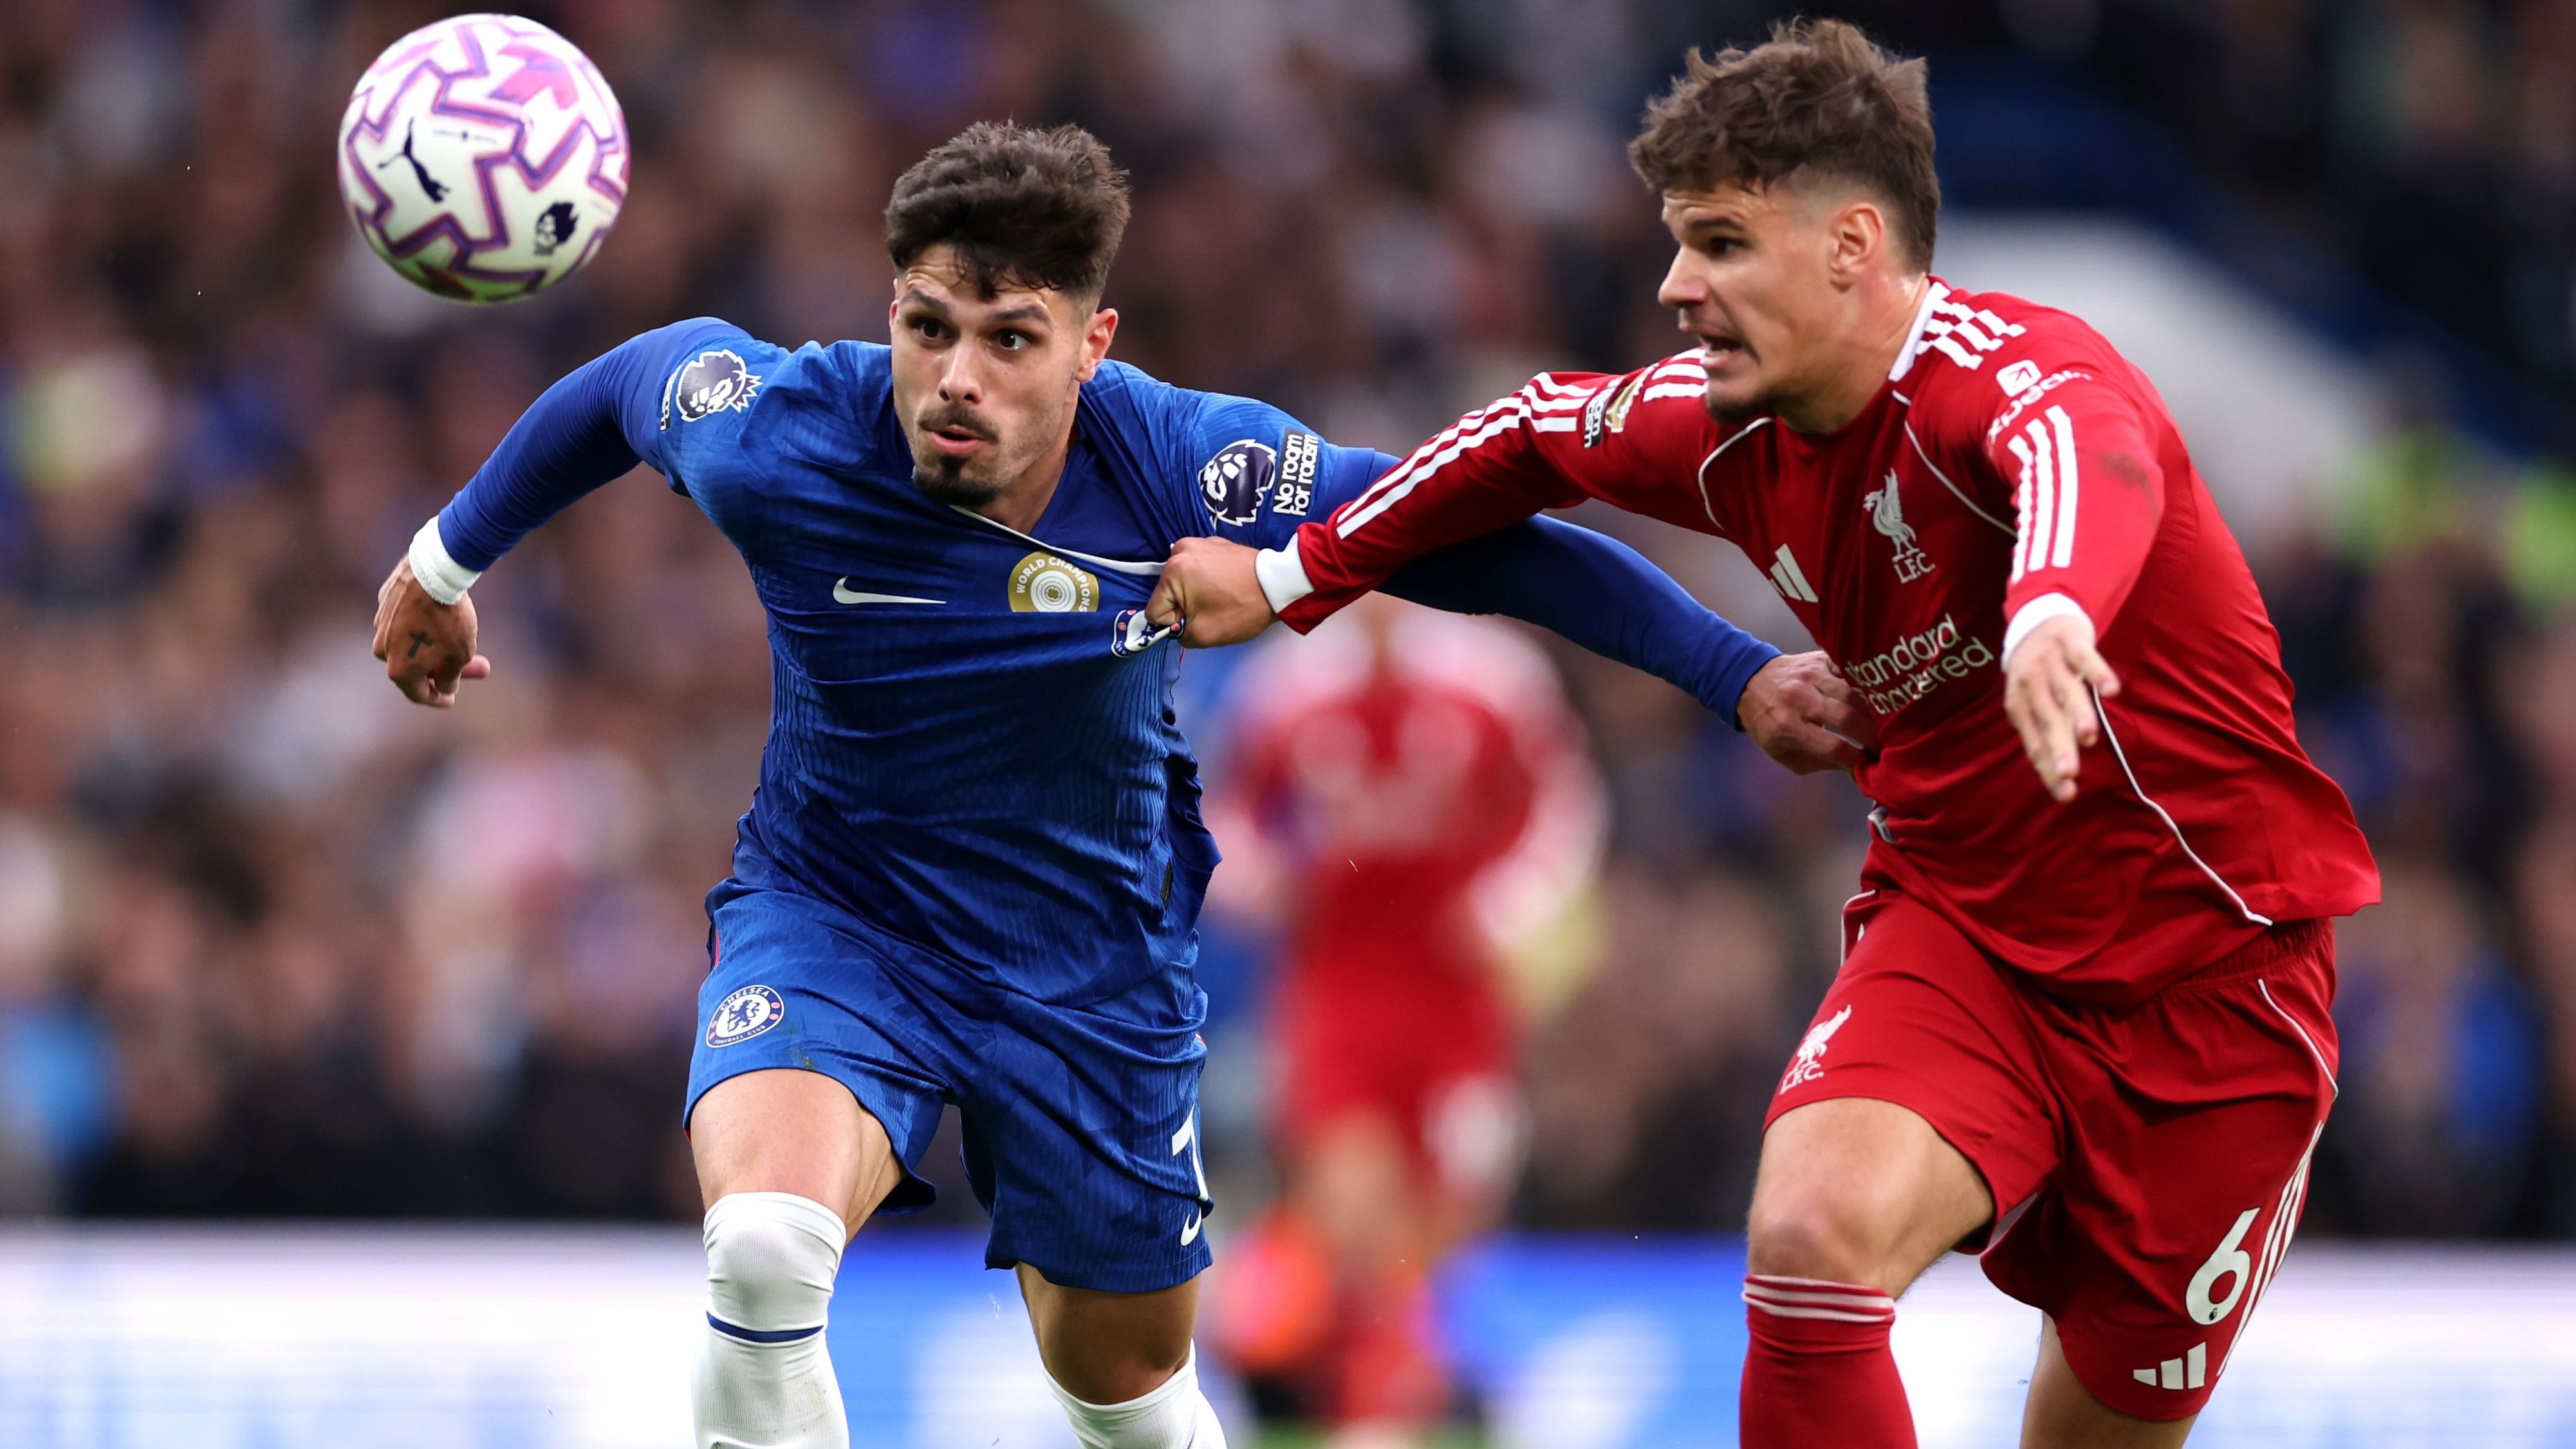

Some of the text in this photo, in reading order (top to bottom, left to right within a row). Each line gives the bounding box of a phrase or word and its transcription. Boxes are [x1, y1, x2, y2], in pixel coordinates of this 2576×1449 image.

[1273, 434, 1303, 515] No room
[1290, 434, 1319, 517] For racism
[1016, 556, 1091, 613] WORLD CHAMPIONS
[720, 987, 770, 1011] CHELSEA
[714, 1025, 766, 1044] FOOTBALL CLUB
[2185, 1207, 2261, 1325] 6
